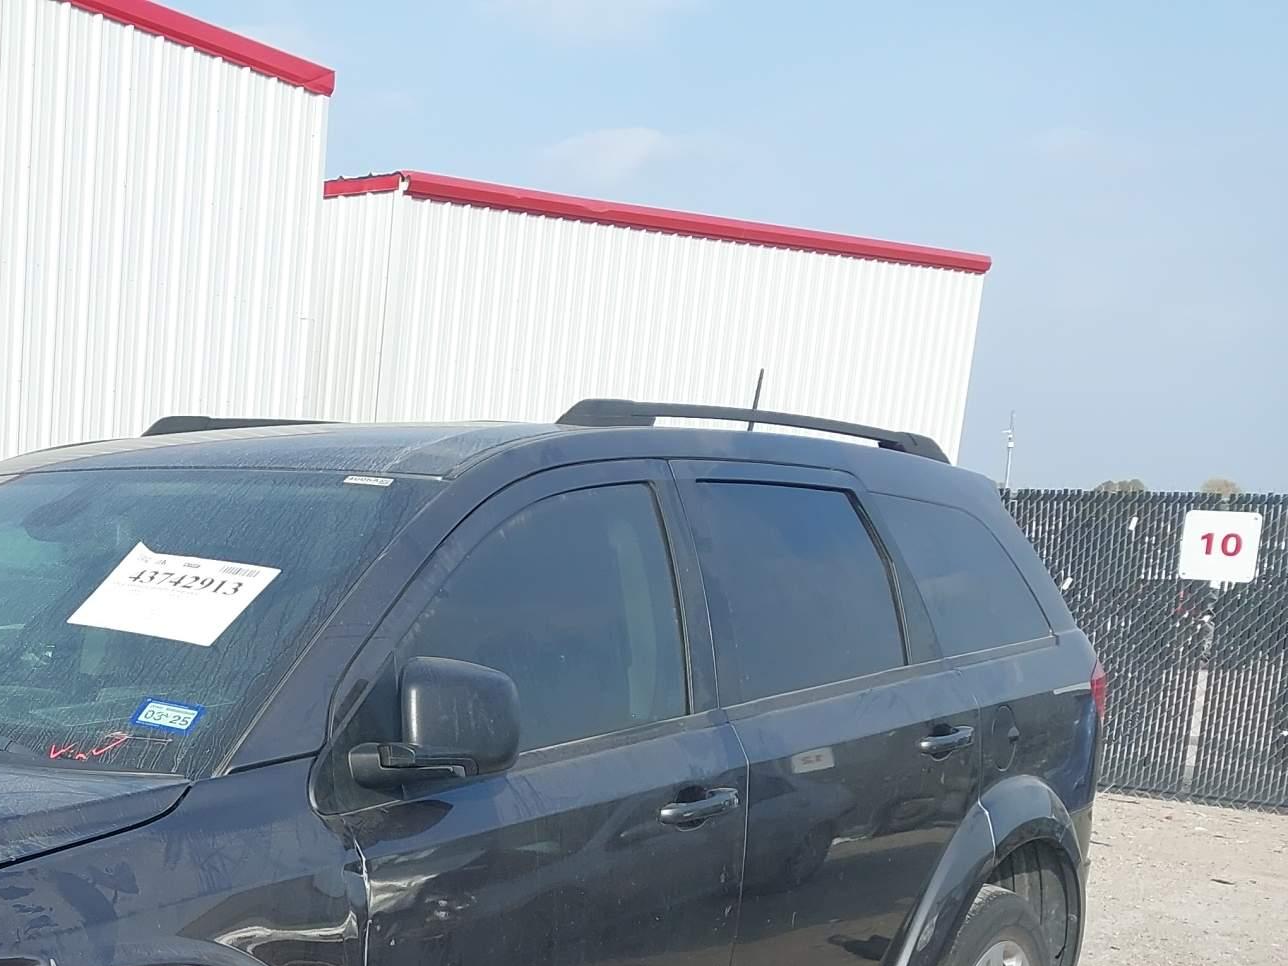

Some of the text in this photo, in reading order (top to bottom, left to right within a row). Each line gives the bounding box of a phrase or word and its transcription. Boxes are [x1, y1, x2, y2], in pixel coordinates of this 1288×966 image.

[1201, 532, 1243, 556] 10
[128, 569, 243, 596] 43742913
[169, 714, 191, 726] 25
